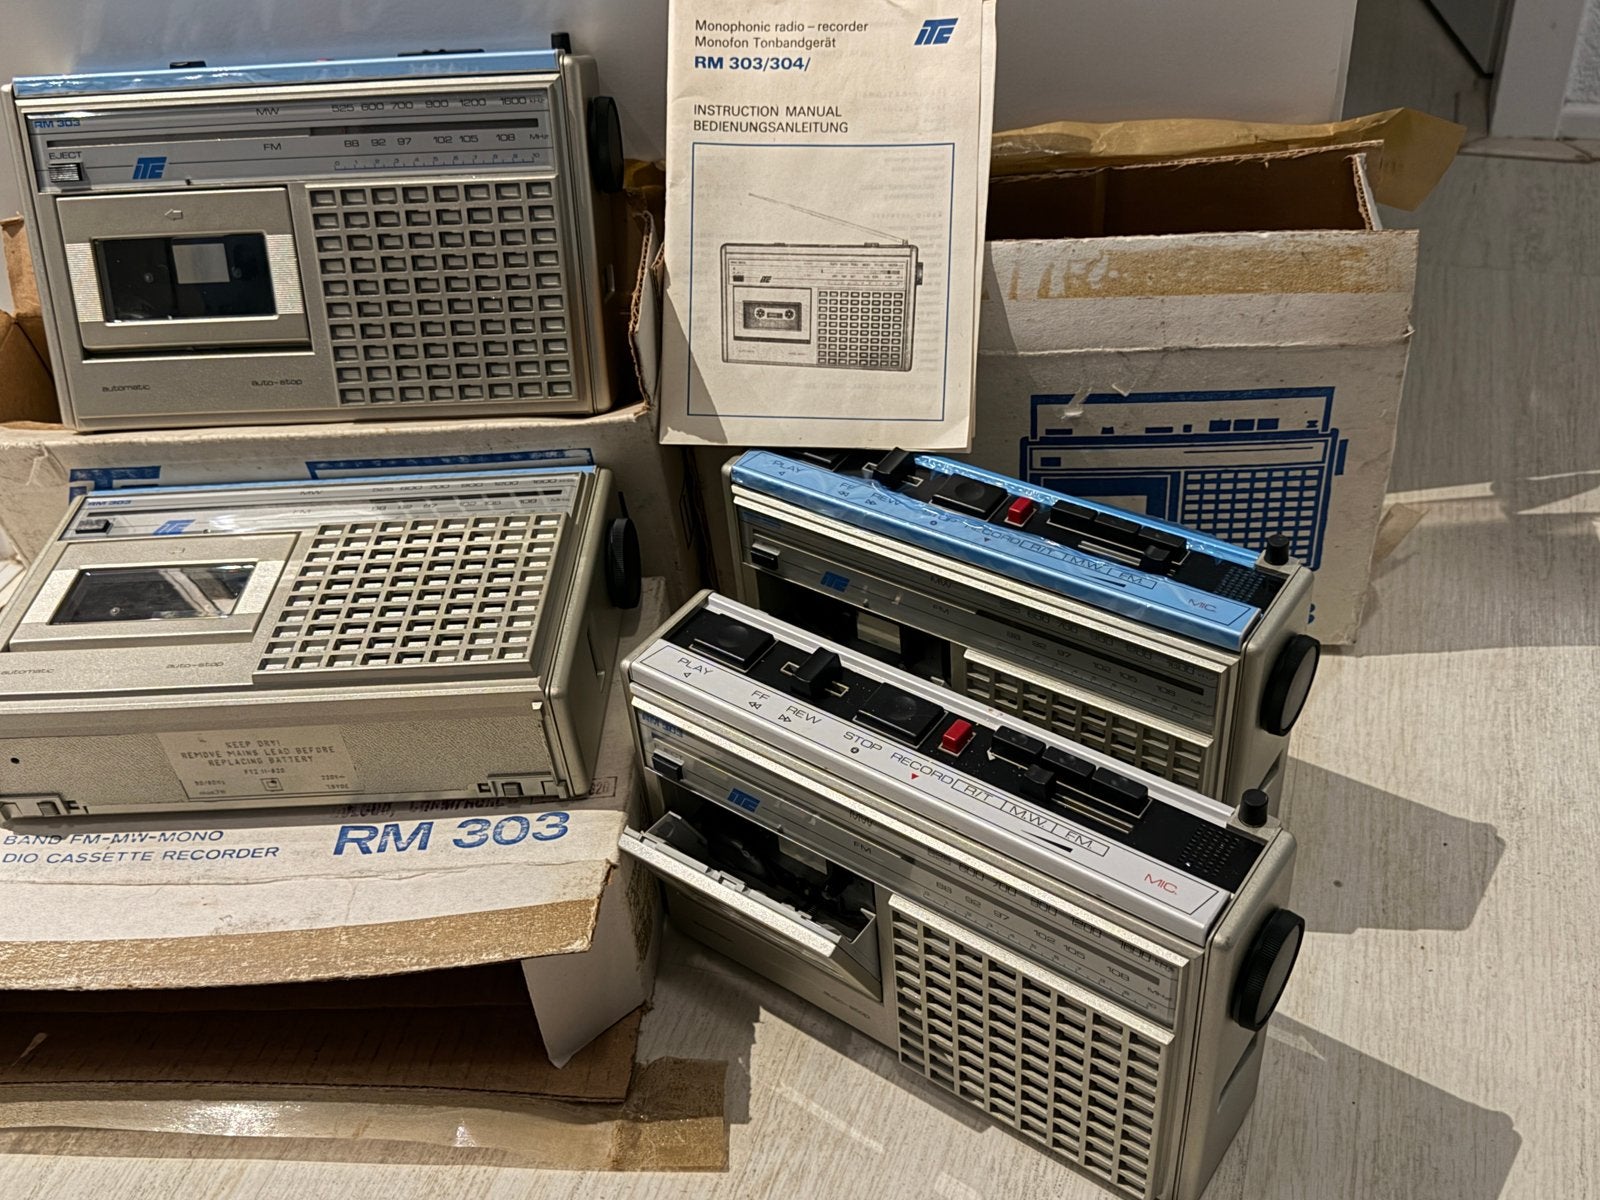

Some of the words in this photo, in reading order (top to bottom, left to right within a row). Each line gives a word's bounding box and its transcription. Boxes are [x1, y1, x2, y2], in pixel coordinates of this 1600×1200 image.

[695, 20, 771, 33] Monophonic
[774, 21, 805, 32] radio
[817, 21, 869, 32] recorder
[695, 36, 749, 48] Monofon
[754, 36, 836, 50] Tonbandgerät
[694, 56, 724, 70] RM
[729, 57, 811, 71] 303/304/
[256, 107, 280, 116] MW
[331, 103, 355, 112] 525
[360, 102, 385, 111] 600
[390, 101, 414, 110] 700
[424, 99, 449, 109] 900
[459, 97, 487, 107] 1200
[693, 104, 779, 117] INSTRUCTION
[785, 106, 842, 118] MANUAL
[34, 120, 54, 129] RM
[57, 119, 81, 128] 303
[693, 120, 849, 133] BEDIENUNGSANLEITUNG
[263, 143, 282, 151] FM
[344, 140, 359, 148] 88
[370, 138, 386, 147] 92
[397, 137, 412, 146] 97
[433, 136, 453, 144] 102
[459, 134, 479, 143] 105
[496, 133, 516, 142] 108
[49, 152, 82, 160] EJECT
[102, 384, 150, 392] automatic
[772, 460, 804, 473] PLAY
[677, 657, 714, 676] PLAY
[751, 690, 770, 700] FF
[786, 705, 822, 724] REW
[225, 740, 250, 749] KEEP
[843, 731, 883, 751] STOP
[181, 751, 222, 760] REMOVE
[227, 749, 258, 758] MAINS
[265, 748, 289, 756] LEAD
[297, 746, 335, 754] BEFORE
[208, 757, 263, 766] REPLACING
[269, 755, 313, 764] BATTERY
[890, 752, 954, 785] RECORD
[964, 785, 993, 801] R/T
[3, 834, 62, 845] BAND
[70, 830, 224, 845] FM-MW-MONO
[333, 821, 435, 856] RM
[452, 811, 570, 849] 303
[46, 851, 154, 864] CASSETTE
[162, 847, 280, 861] RECORDER
[1144, 872, 1178, 894] MIC.
